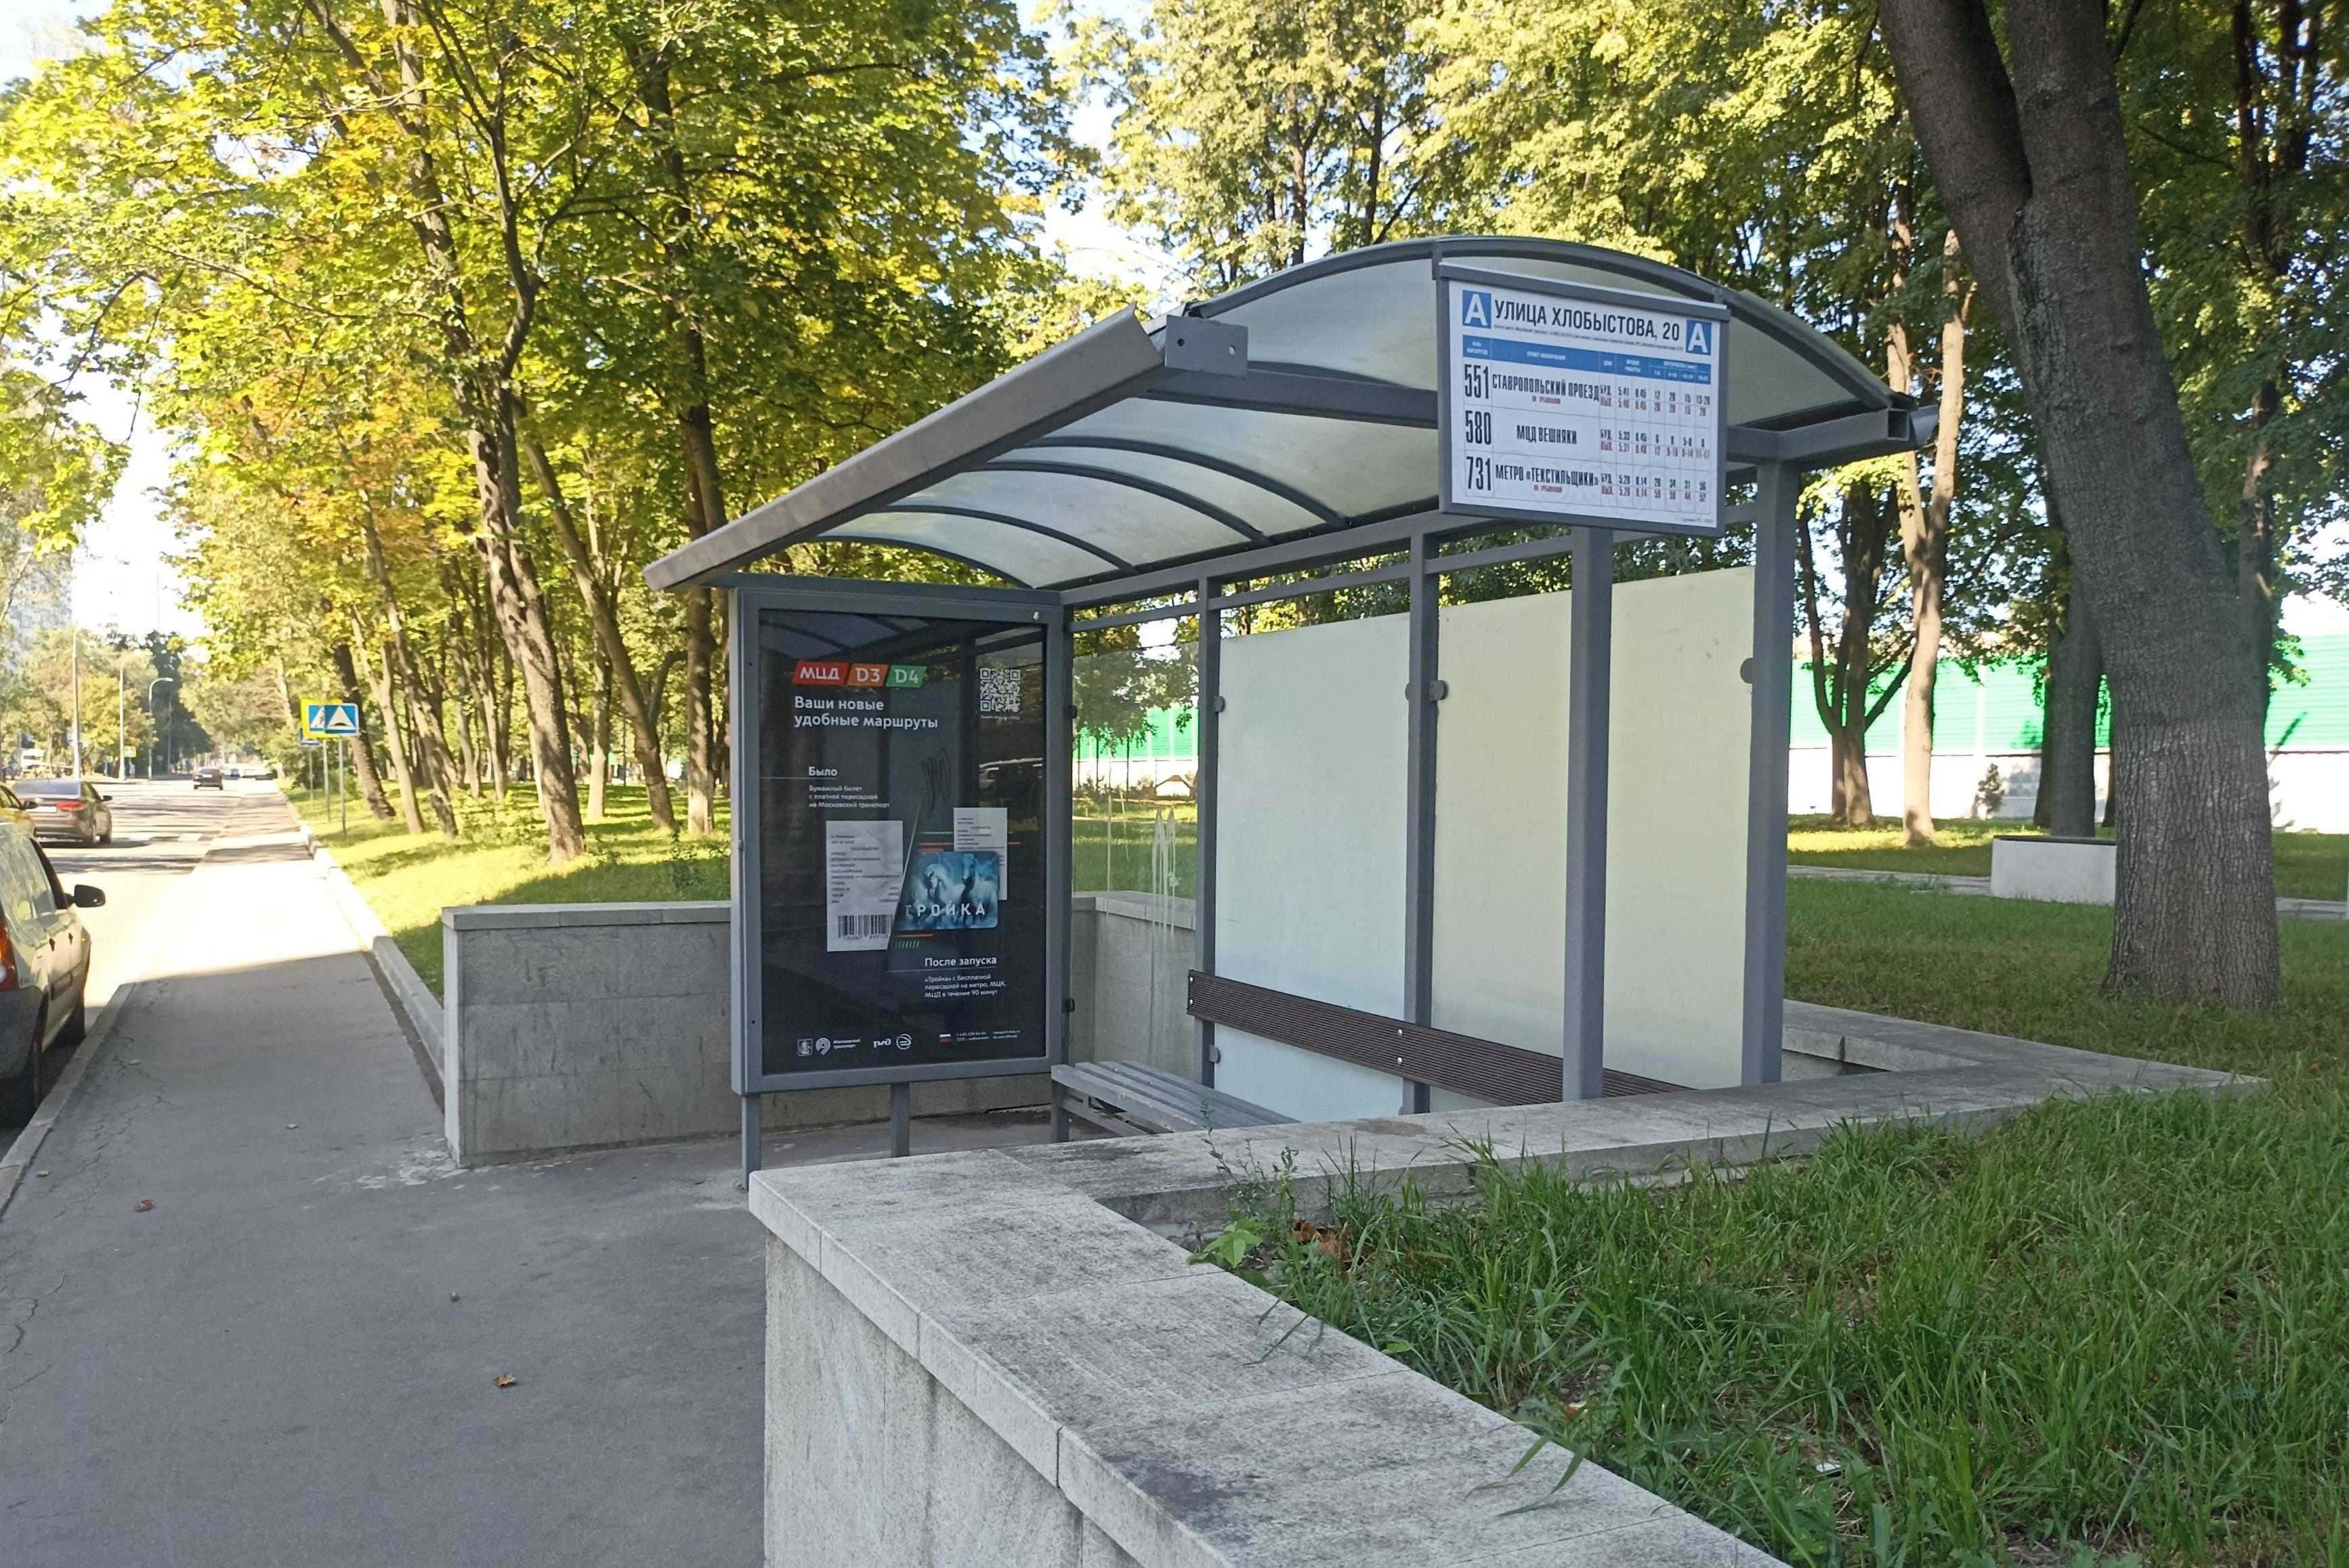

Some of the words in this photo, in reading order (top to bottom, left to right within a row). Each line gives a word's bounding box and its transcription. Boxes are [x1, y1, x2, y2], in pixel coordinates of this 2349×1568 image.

[1494, 299, 1547, 326] УЛИЦА
[1552, 307, 1657, 341] ХЛОБЫСТОВА,
[1663, 322, 1680, 341] 20
[1464, 364, 1489, 399] 551
[1492, 374, 1566, 396] СТАВРОПОЛЬСКИЙ
[1568, 382, 1599, 401] ПРОЕЗД
[1465, 410, 1491, 445] 580
[1517, 425, 1536, 443] МЦД
[1539, 427, 1577, 444] ВЕШНЯКИ
[1466, 457, 1491, 491] 731
[1496, 465, 1523, 481] МЕТРО
[1526, 467, 1599, 487] «ТЕКСТИЛЬЩИКИ»
[800, 666, 840, 680] МЦД
[855, 668, 880, 683] D3
[894, 669, 919, 683] D4
[795, 696, 834, 709] Ваши
[839, 700, 885, 711] новые
[794, 713, 860, 727] удобные
[863, 717, 938, 730] маршруты
[809, 766, 838, 776] Было
[906, 900, 986, 916] ТРОЙКА
[925, 958, 956, 967] После
[959, 957, 997, 967] запуска
